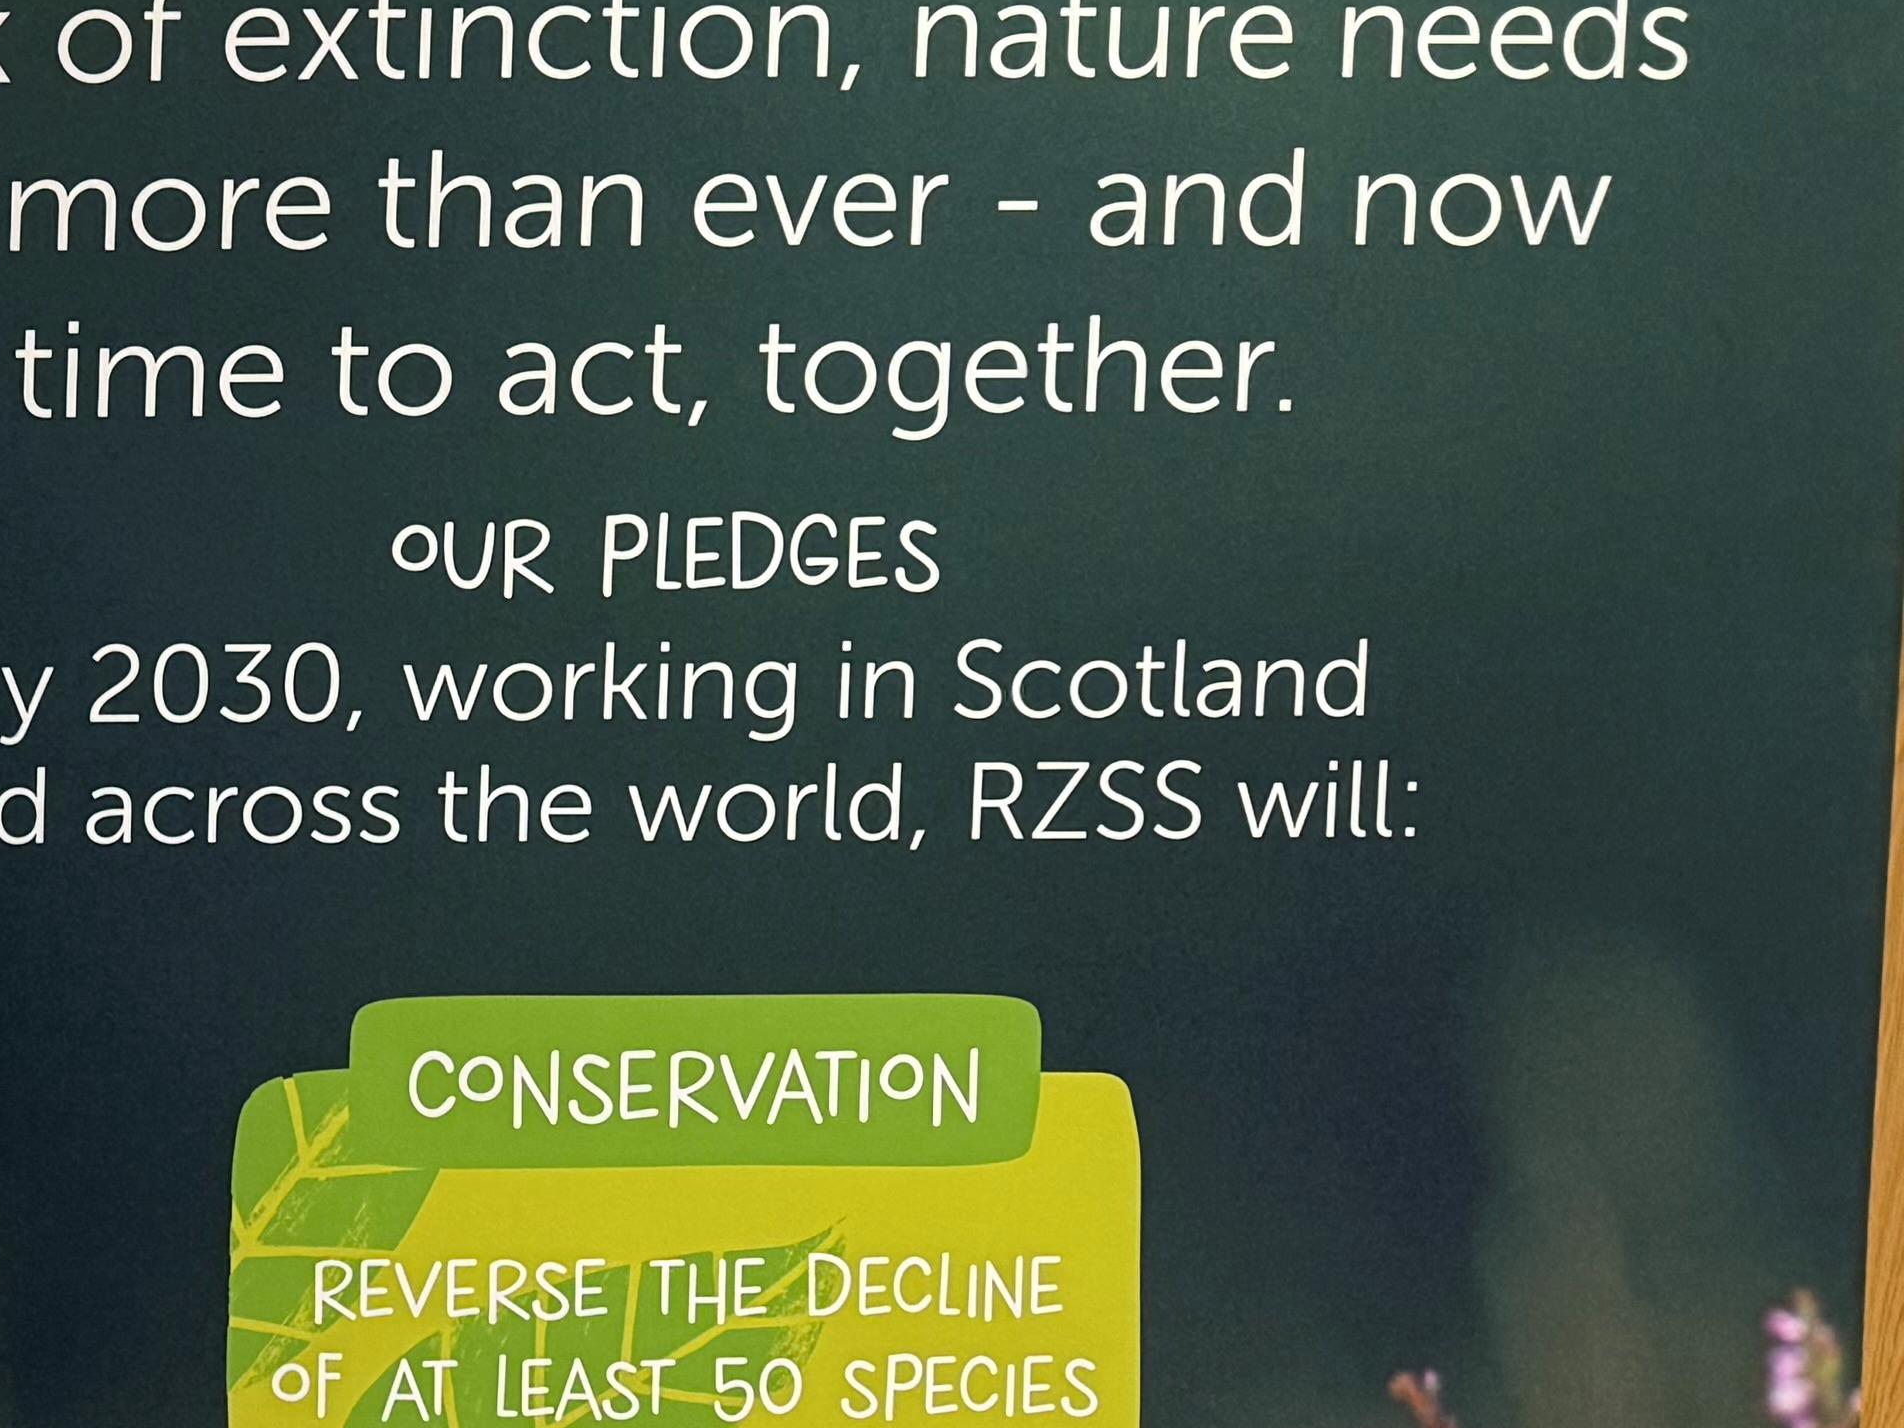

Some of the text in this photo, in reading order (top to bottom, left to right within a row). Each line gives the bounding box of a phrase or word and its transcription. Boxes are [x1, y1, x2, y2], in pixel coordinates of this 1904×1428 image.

[10, 177, 330, 251] more
[379, 150, 642, 248] than
[694, 174, 948, 247] ever
[1090, 148, 1304, 246] and
[1356, 174, 1611, 246] now
[16, 321, 283, 418] time
[332, 327, 452, 416] to
[499, 325, 707, 426] act,
[759, 315, 1291, 440] together.
[392, 511, 939, 599] OUR PLEDGES
[90, 643, 361, 731] 2030,
[404, 642, 796, 741] working
[840, 641, 913, 718] in
[954, 639, 1367, 719] Scotland
[87, 786, 399, 844] across
[438, 765, 591, 842] the
[629, 763, 924, 850] world,
[972, 760, 1201, 840] RZSS
[1238, 760, 1417, 837] will:
[409, 1048, 978, 1128] CONSERVATION
[315, 1253, 1062, 1324] REVERSE THE DECLINE
[273, 1353, 1098, 1421] OF AT LEAST 50 SPECIES
